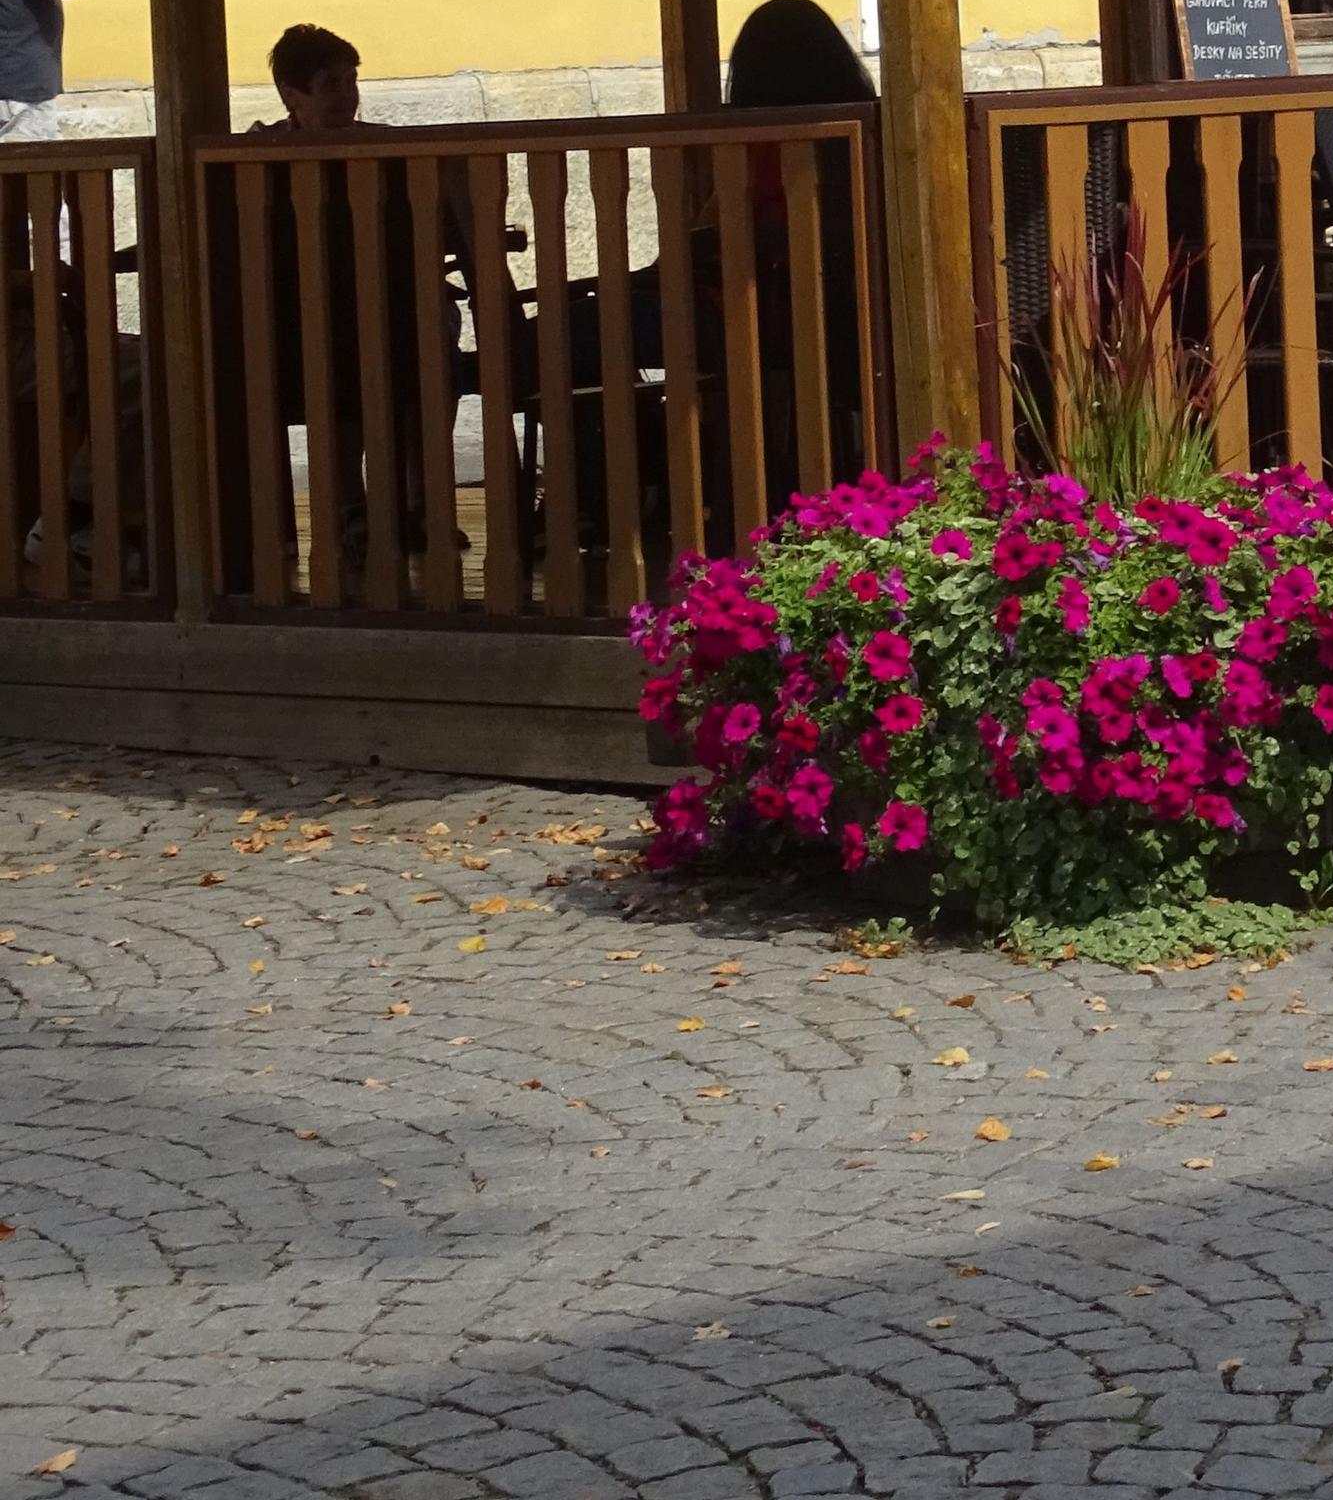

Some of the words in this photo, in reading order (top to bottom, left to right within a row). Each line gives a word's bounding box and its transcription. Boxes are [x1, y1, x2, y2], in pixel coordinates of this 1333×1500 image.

[1193, 44, 1225, 60] DESKY
[1228, 46, 1242, 60] NA
[1245, 40, 1282, 60] SEŠITY
